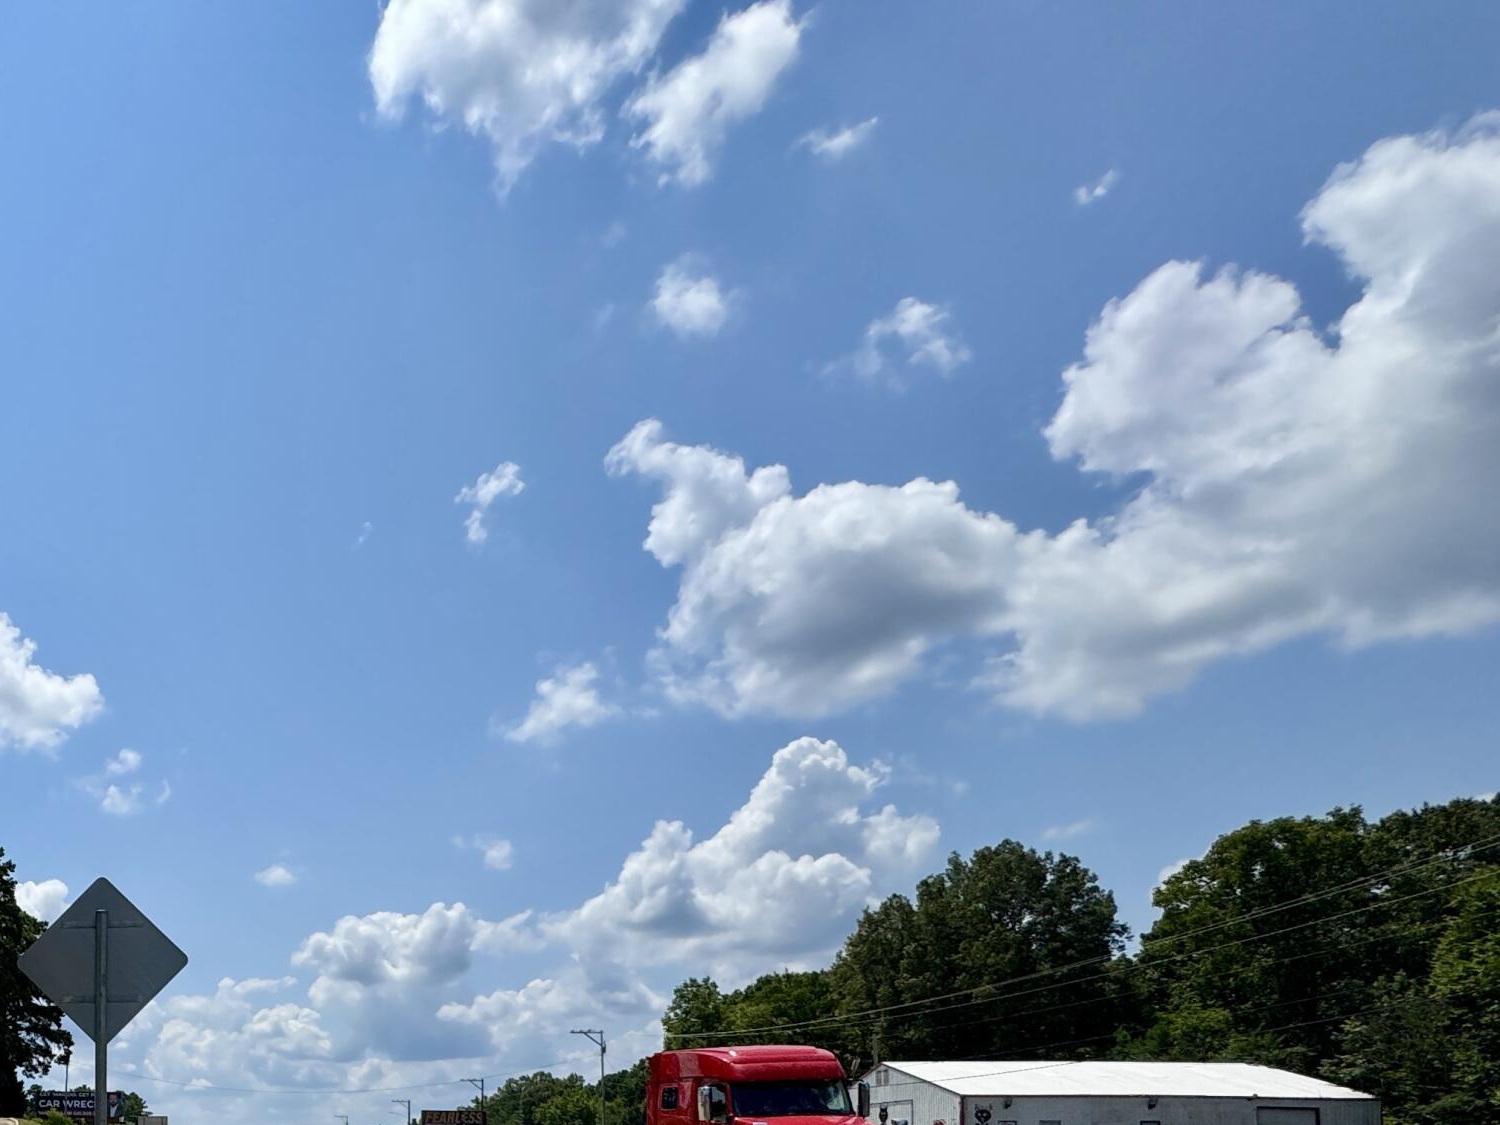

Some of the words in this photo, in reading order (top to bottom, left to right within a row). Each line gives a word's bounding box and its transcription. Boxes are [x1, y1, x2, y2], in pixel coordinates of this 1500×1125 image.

[38, 1099, 60, 1108] CAR
[63, 1100, 94, 1109] WREC
[426, 1111, 482, 1124] FEARLESS
